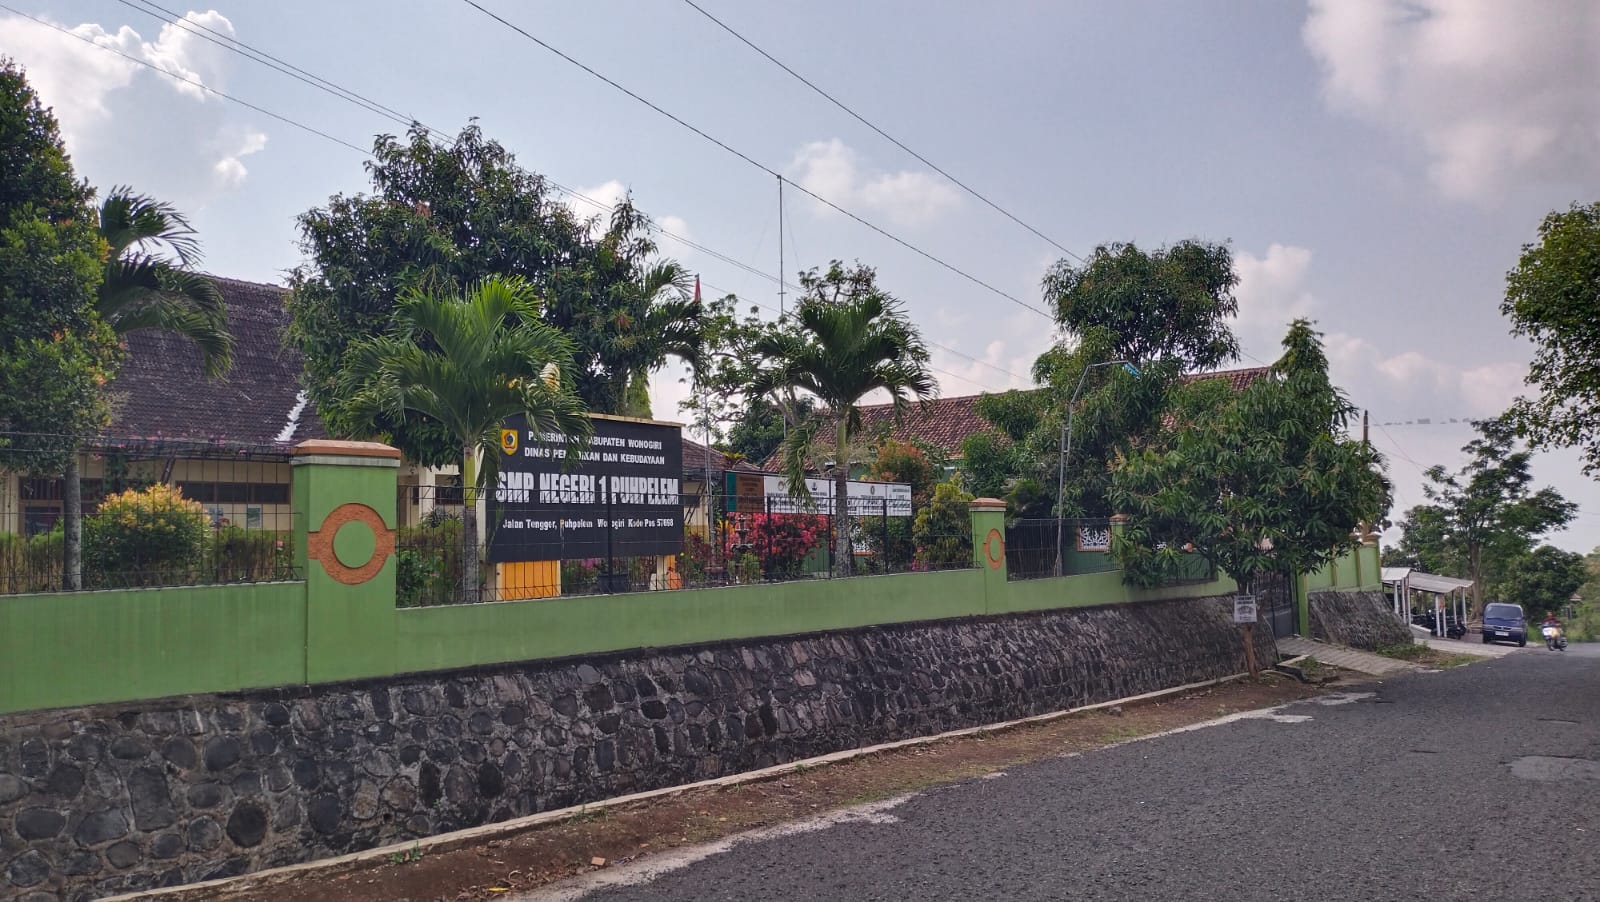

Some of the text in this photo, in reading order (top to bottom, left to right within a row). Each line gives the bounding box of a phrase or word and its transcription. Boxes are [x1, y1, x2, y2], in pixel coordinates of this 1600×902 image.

[584, 435, 626, 448] ABUPATEN
[628, 439, 662, 450] WONOGIRI
[524, 447, 550, 458] DINAS
[603, 452, 618, 463] DAN
[621, 453, 665, 465] KEBUDAYAAN
[495, 471, 679, 505] SMP NEGERI 1 PUHPELEM
[503, 518, 524, 529] Jalan
[597, 518, 625, 530] Woogiri
